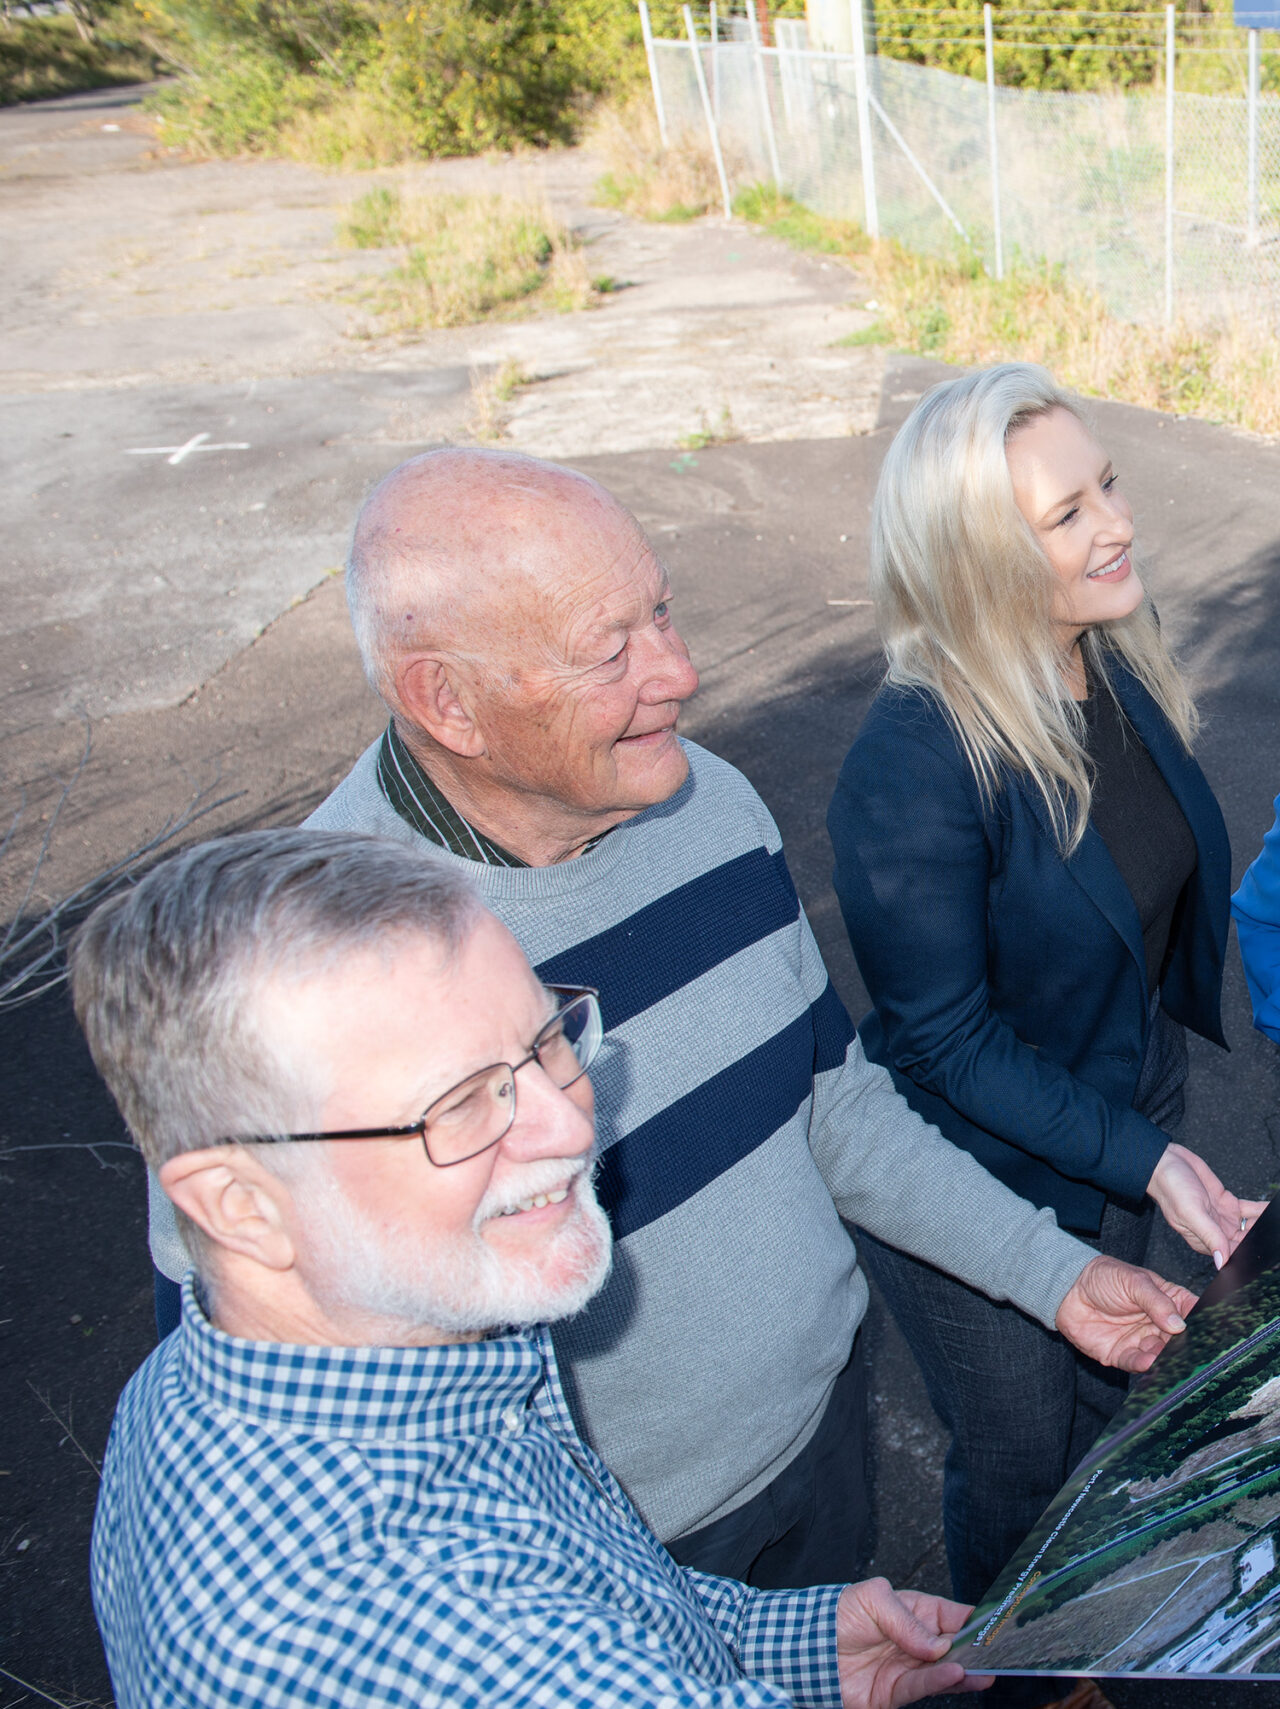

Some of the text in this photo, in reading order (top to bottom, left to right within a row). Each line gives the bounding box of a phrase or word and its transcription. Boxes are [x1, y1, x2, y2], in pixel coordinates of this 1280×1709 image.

[1088, 1469, 1104, 1485] Port
[1055, 1492, 1087, 1531] Newcastle
[1038, 1531, 1059, 1554] Clean
[1017, 1554, 1043, 1582] Energy
[994, 1582, 1023, 1617] Precinct
